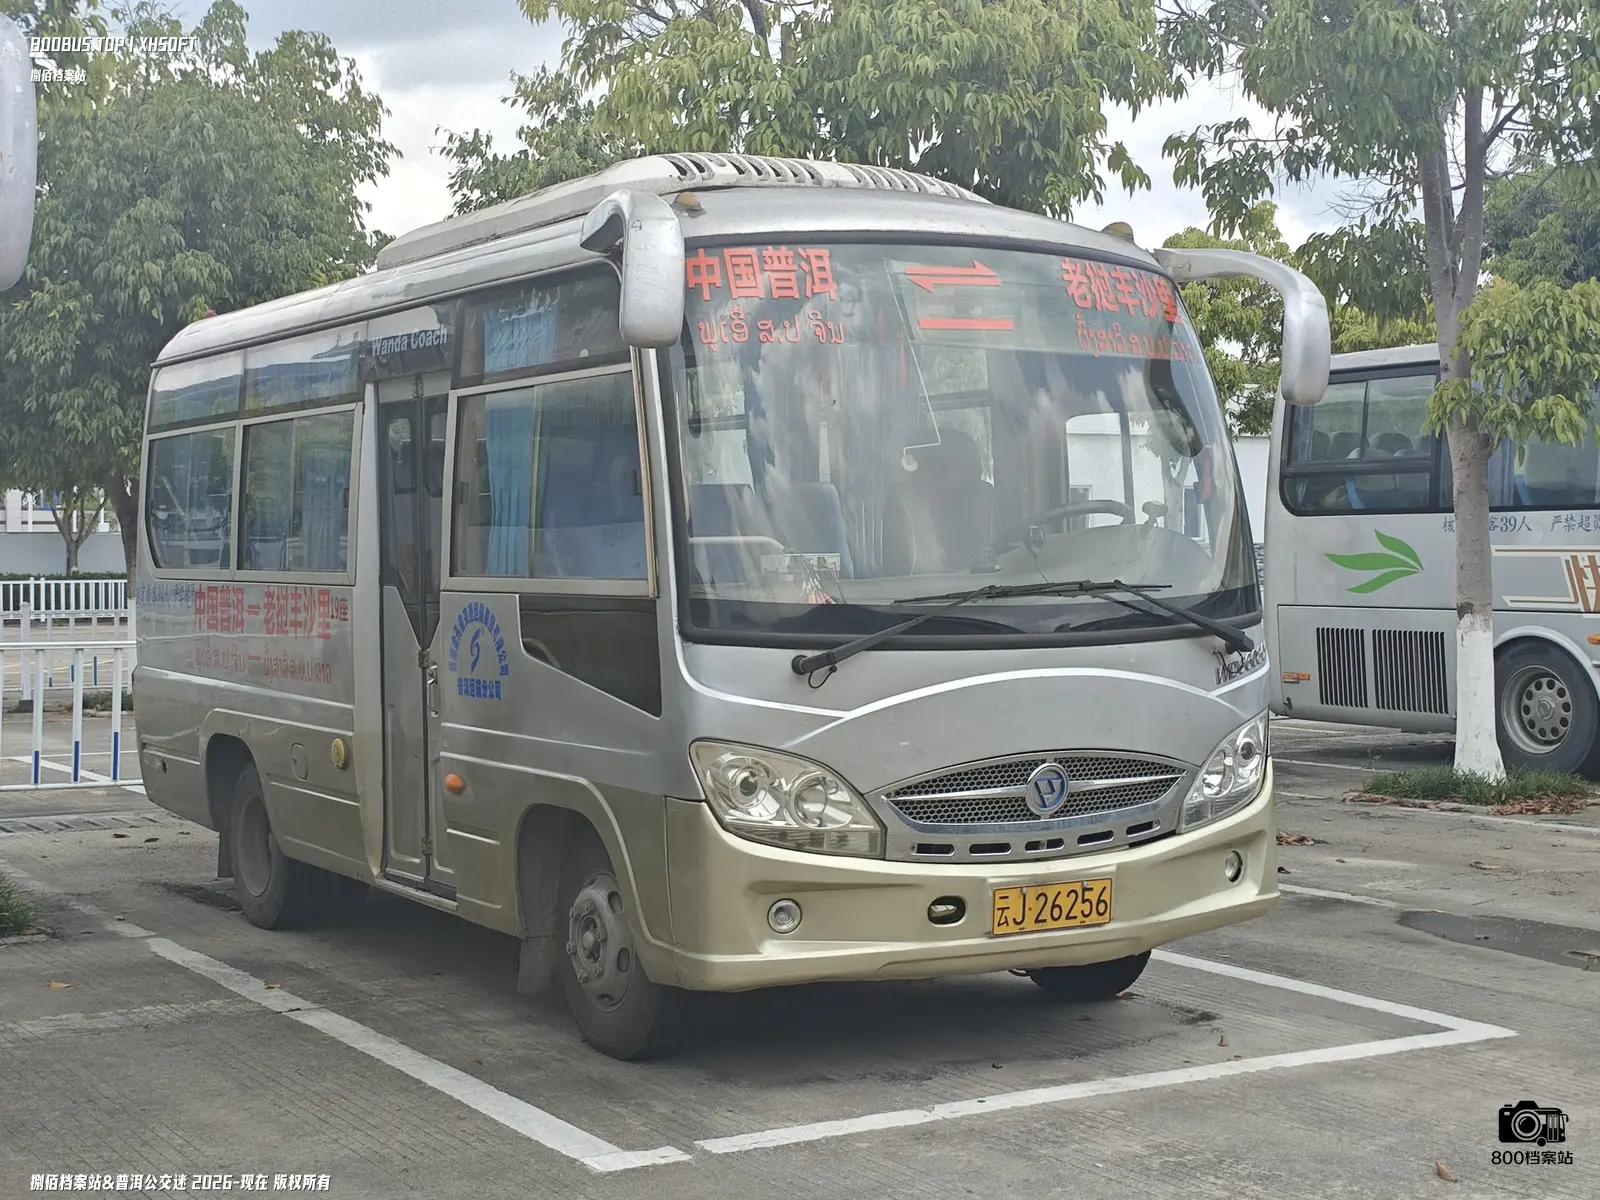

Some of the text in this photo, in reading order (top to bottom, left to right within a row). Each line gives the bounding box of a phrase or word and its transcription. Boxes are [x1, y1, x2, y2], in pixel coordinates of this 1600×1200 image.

[685, 245, 837, 301] 中国普洱
[1059, 255, 1186, 325] 老挝丰沙里
[371, 322, 448, 358] Wanda Coach
[1442, 515, 1533, 534] 核客39人
[194, 583, 246, 634] 中国普洱
